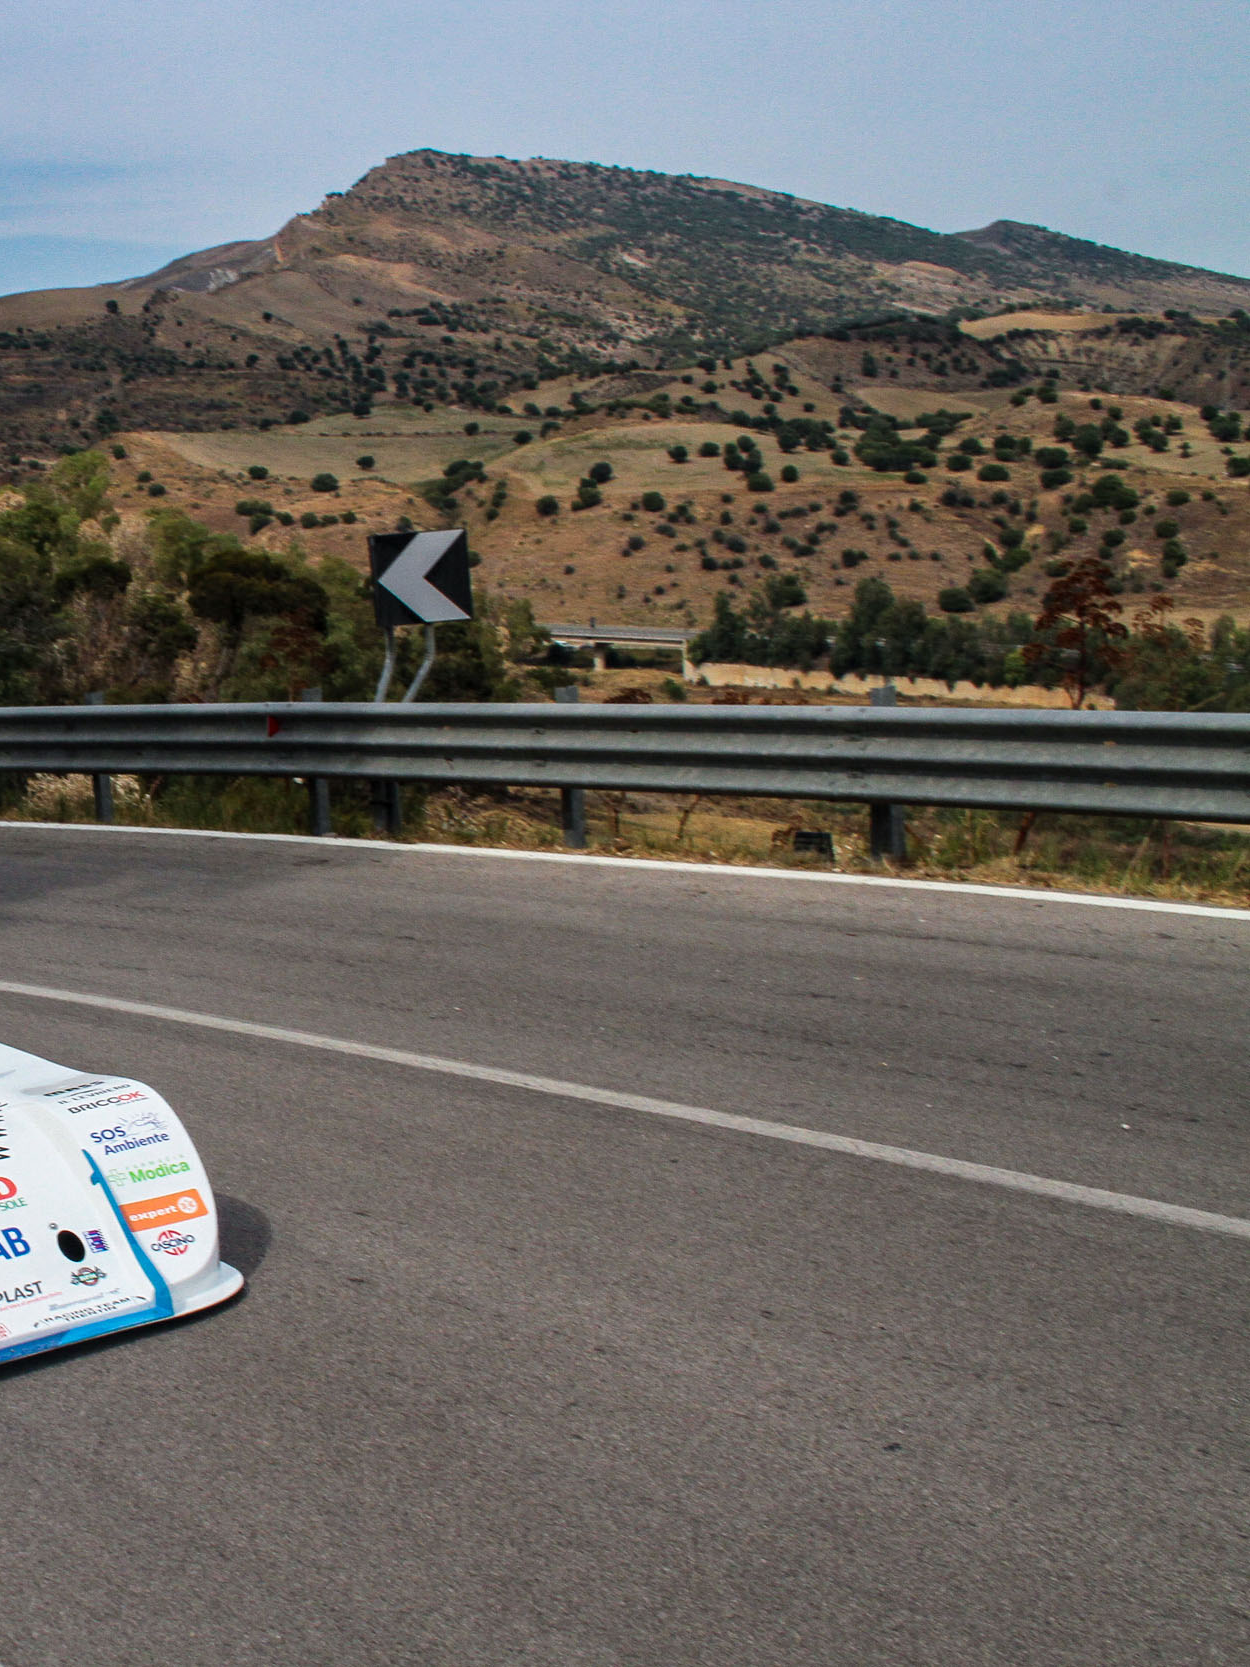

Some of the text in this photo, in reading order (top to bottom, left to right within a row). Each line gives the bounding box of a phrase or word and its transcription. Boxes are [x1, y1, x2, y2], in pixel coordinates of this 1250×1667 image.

[90, 1126, 126, 1143] SOS
[104, 1133, 170, 1155] Ambiente
[128, 1161, 191, 1183] Modica
[0, 1197, 28, 1212] SOLE
[128, 1205, 179, 1222] expert
[150, 1234, 195, 1252] CASCINO
